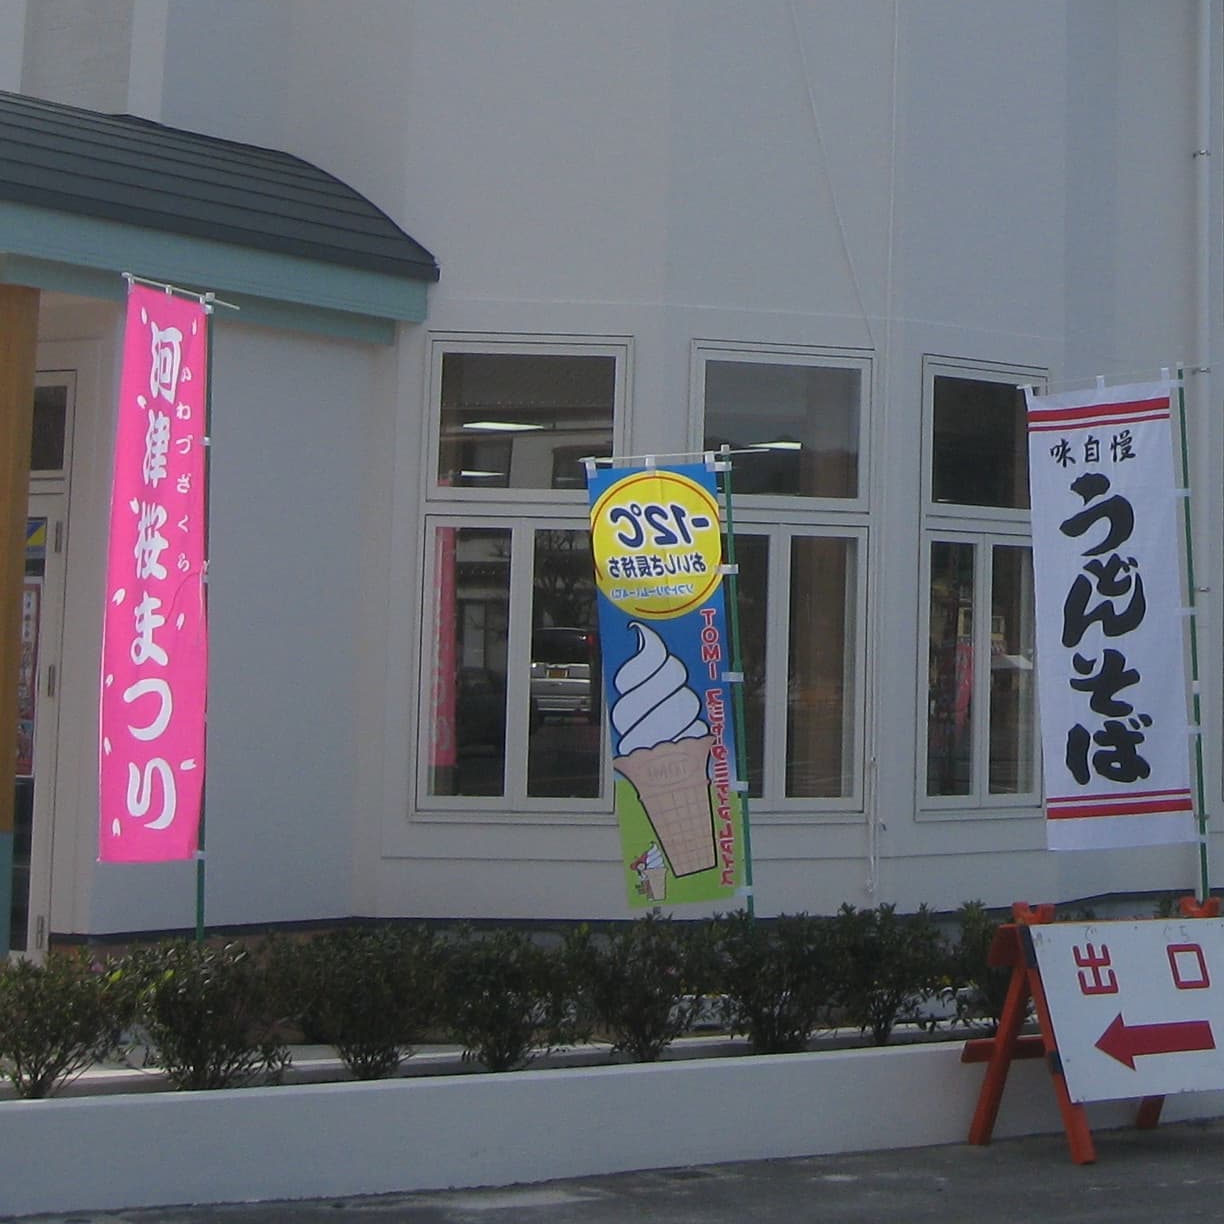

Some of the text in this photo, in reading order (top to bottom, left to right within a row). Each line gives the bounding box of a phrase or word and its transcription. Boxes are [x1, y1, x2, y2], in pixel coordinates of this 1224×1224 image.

[1049, 430, 1137, 468] 味自慢
[123, 322, 183, 830] 河津桜まつり
[1072, 943, 1210, 995] 出口
